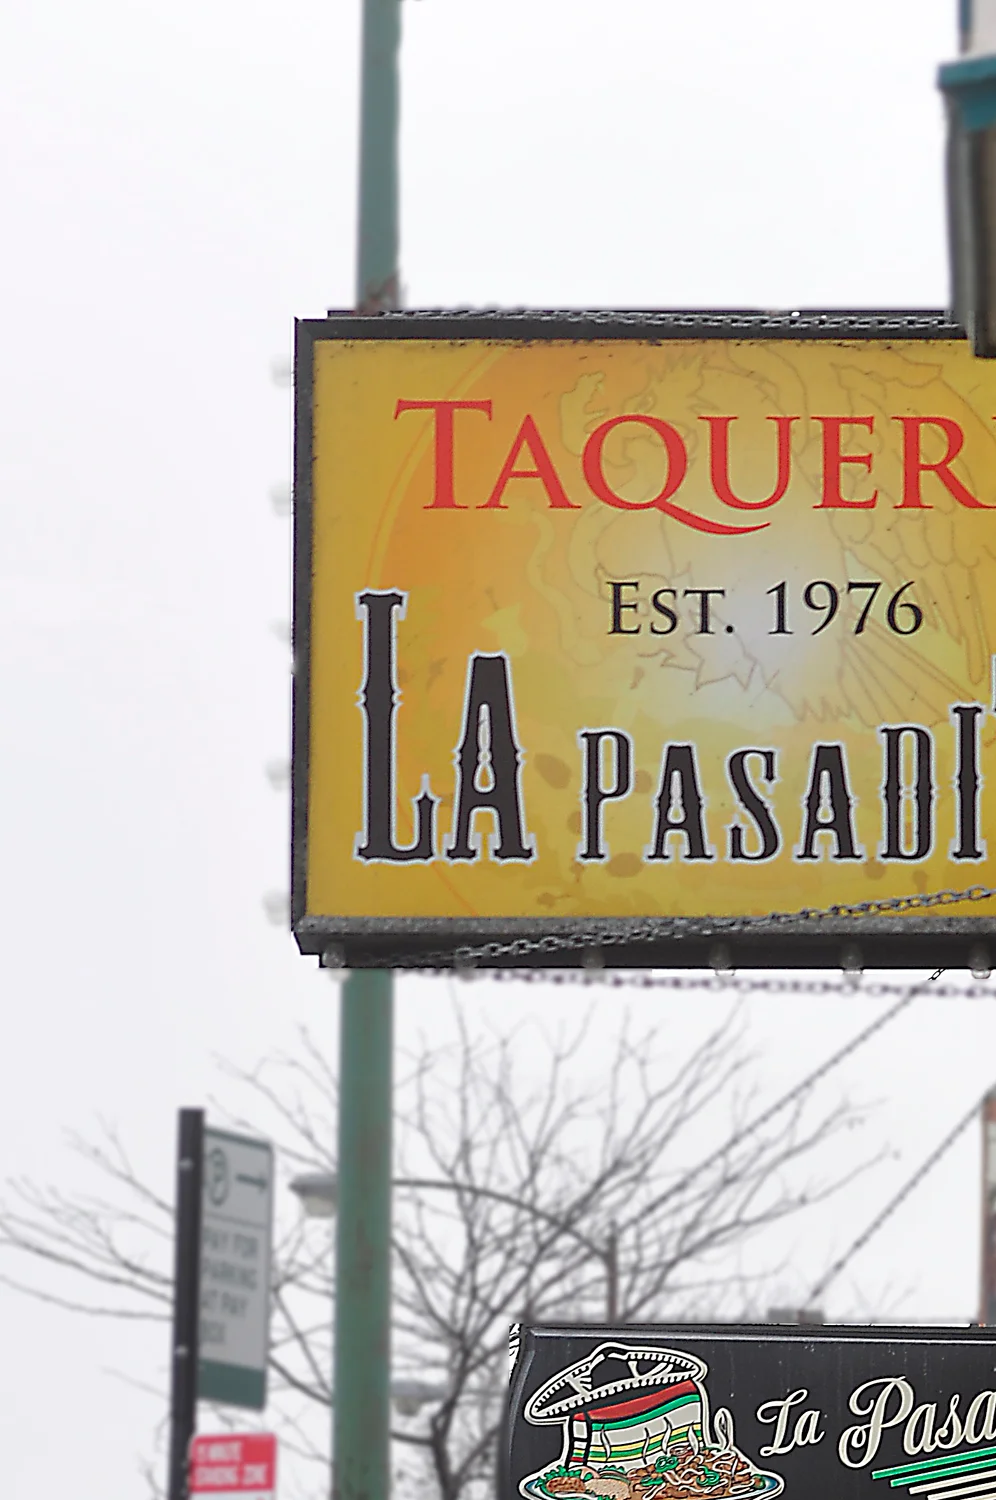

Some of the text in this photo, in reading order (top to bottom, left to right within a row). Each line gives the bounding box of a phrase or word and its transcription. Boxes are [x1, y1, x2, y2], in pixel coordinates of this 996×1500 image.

[606, 580, 924, 636] EST. 1976
[355, 588, 535, 863] LA
[757, 1388, 825, 1457] La
